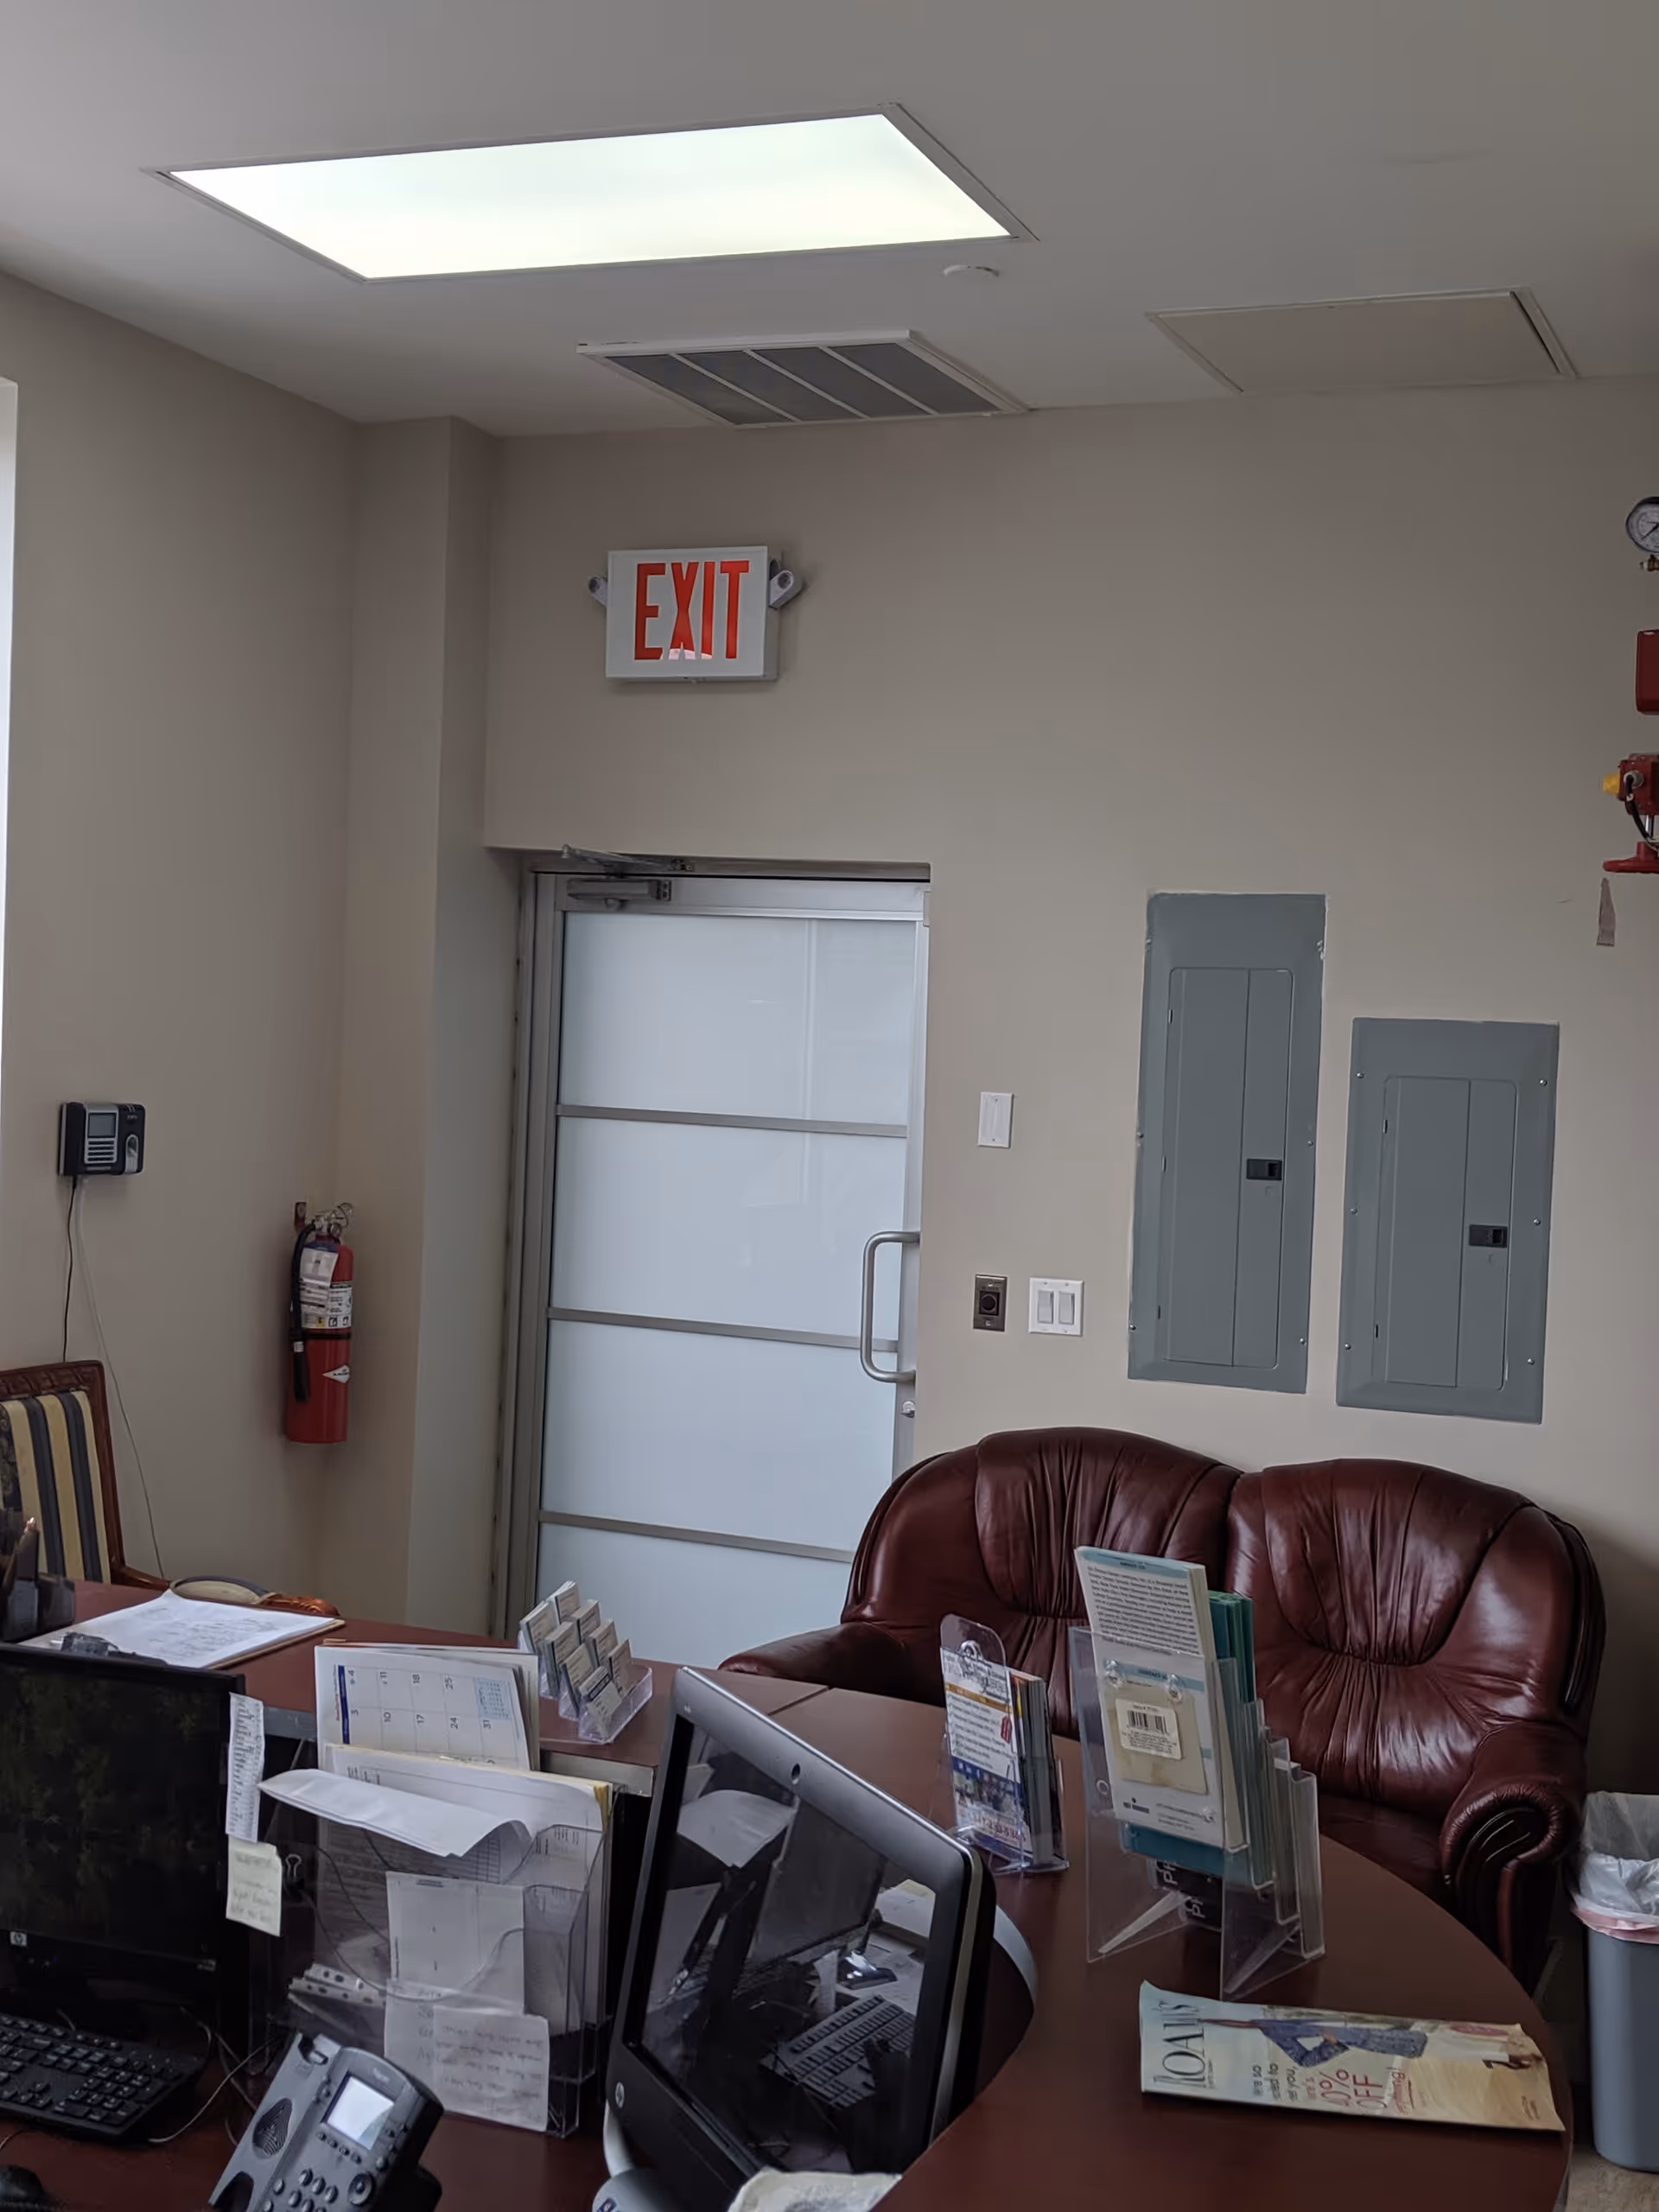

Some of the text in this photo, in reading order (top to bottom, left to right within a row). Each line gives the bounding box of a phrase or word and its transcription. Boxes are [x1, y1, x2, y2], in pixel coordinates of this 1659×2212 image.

[634, 560, 750, 660] EXIT
[412, 1674, 421, 1684] 18
[444, 1676, 454, 1689] 25
[384, 1712, 391, 1723] 10
[416, 1713, 424, 1725] 17
[450, 1716, 459, 1729] 24
[483, 1719, 492, 1729] 31
[1353, 2072, 1385, 2110] OFF
